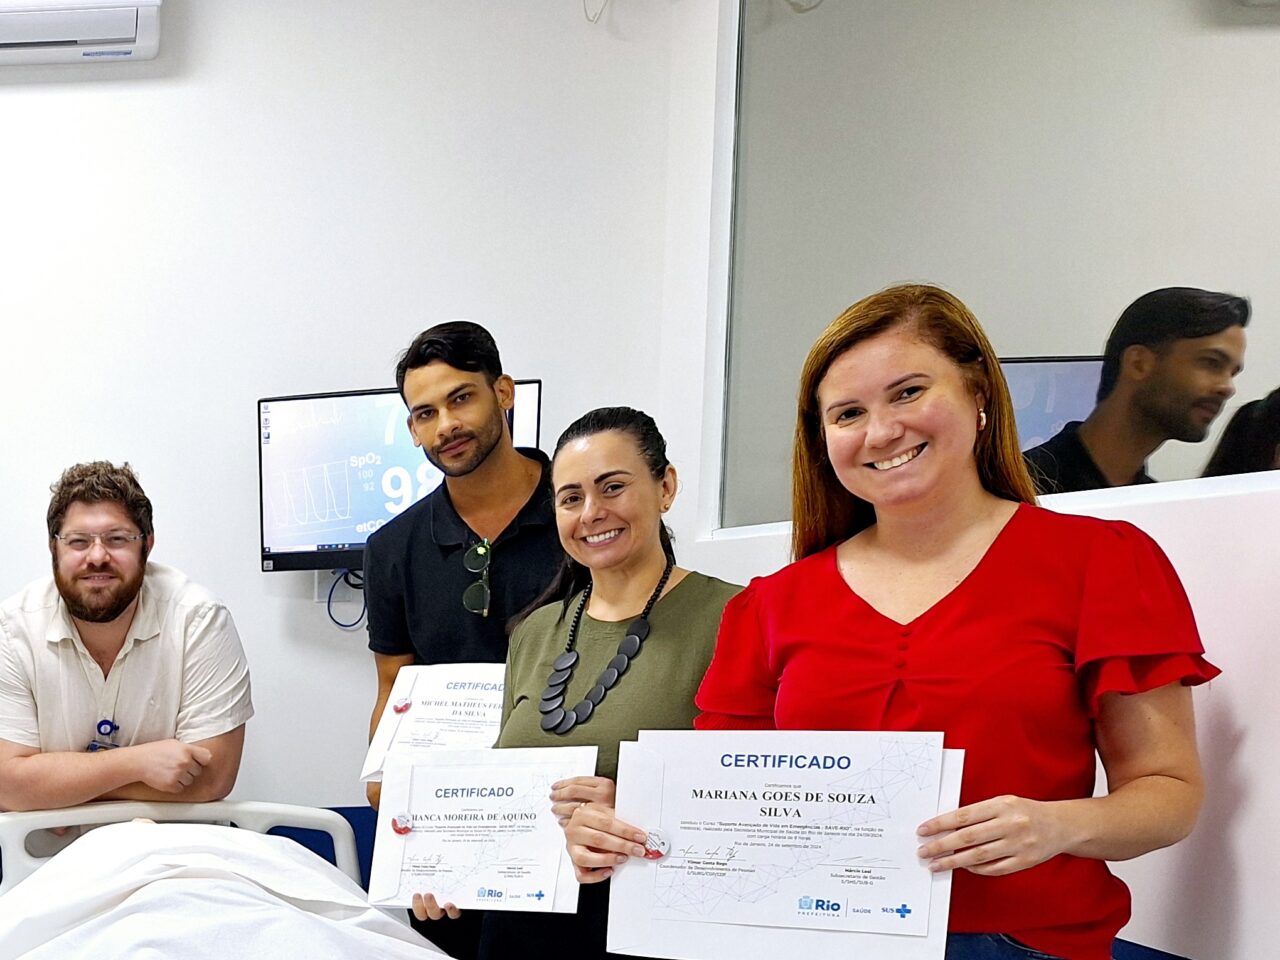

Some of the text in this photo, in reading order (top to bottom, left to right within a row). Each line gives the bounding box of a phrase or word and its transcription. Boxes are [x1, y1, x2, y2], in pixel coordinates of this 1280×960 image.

[357, 469, 374, 480] 100
[446, 681, 505, 692] CERTIFICAD
[451, 700, 487, 708] MATHEUS
[720, 753, 851, 770] CERTIFICADO
[435, 787, 514, 798] CERTIFICADO
[691, 789, 876, 805] MARIANA GOES DE SOUZA
[443, 813, 484, 822] MOREIRA
[486, 812, 499, 821] DE
[501, 812, 537, 822] AQUINO
[759, 806, 802, 818] SILVA
[487, 889, 503, 898] Rio
[815, 899, 841, 912] Rio
